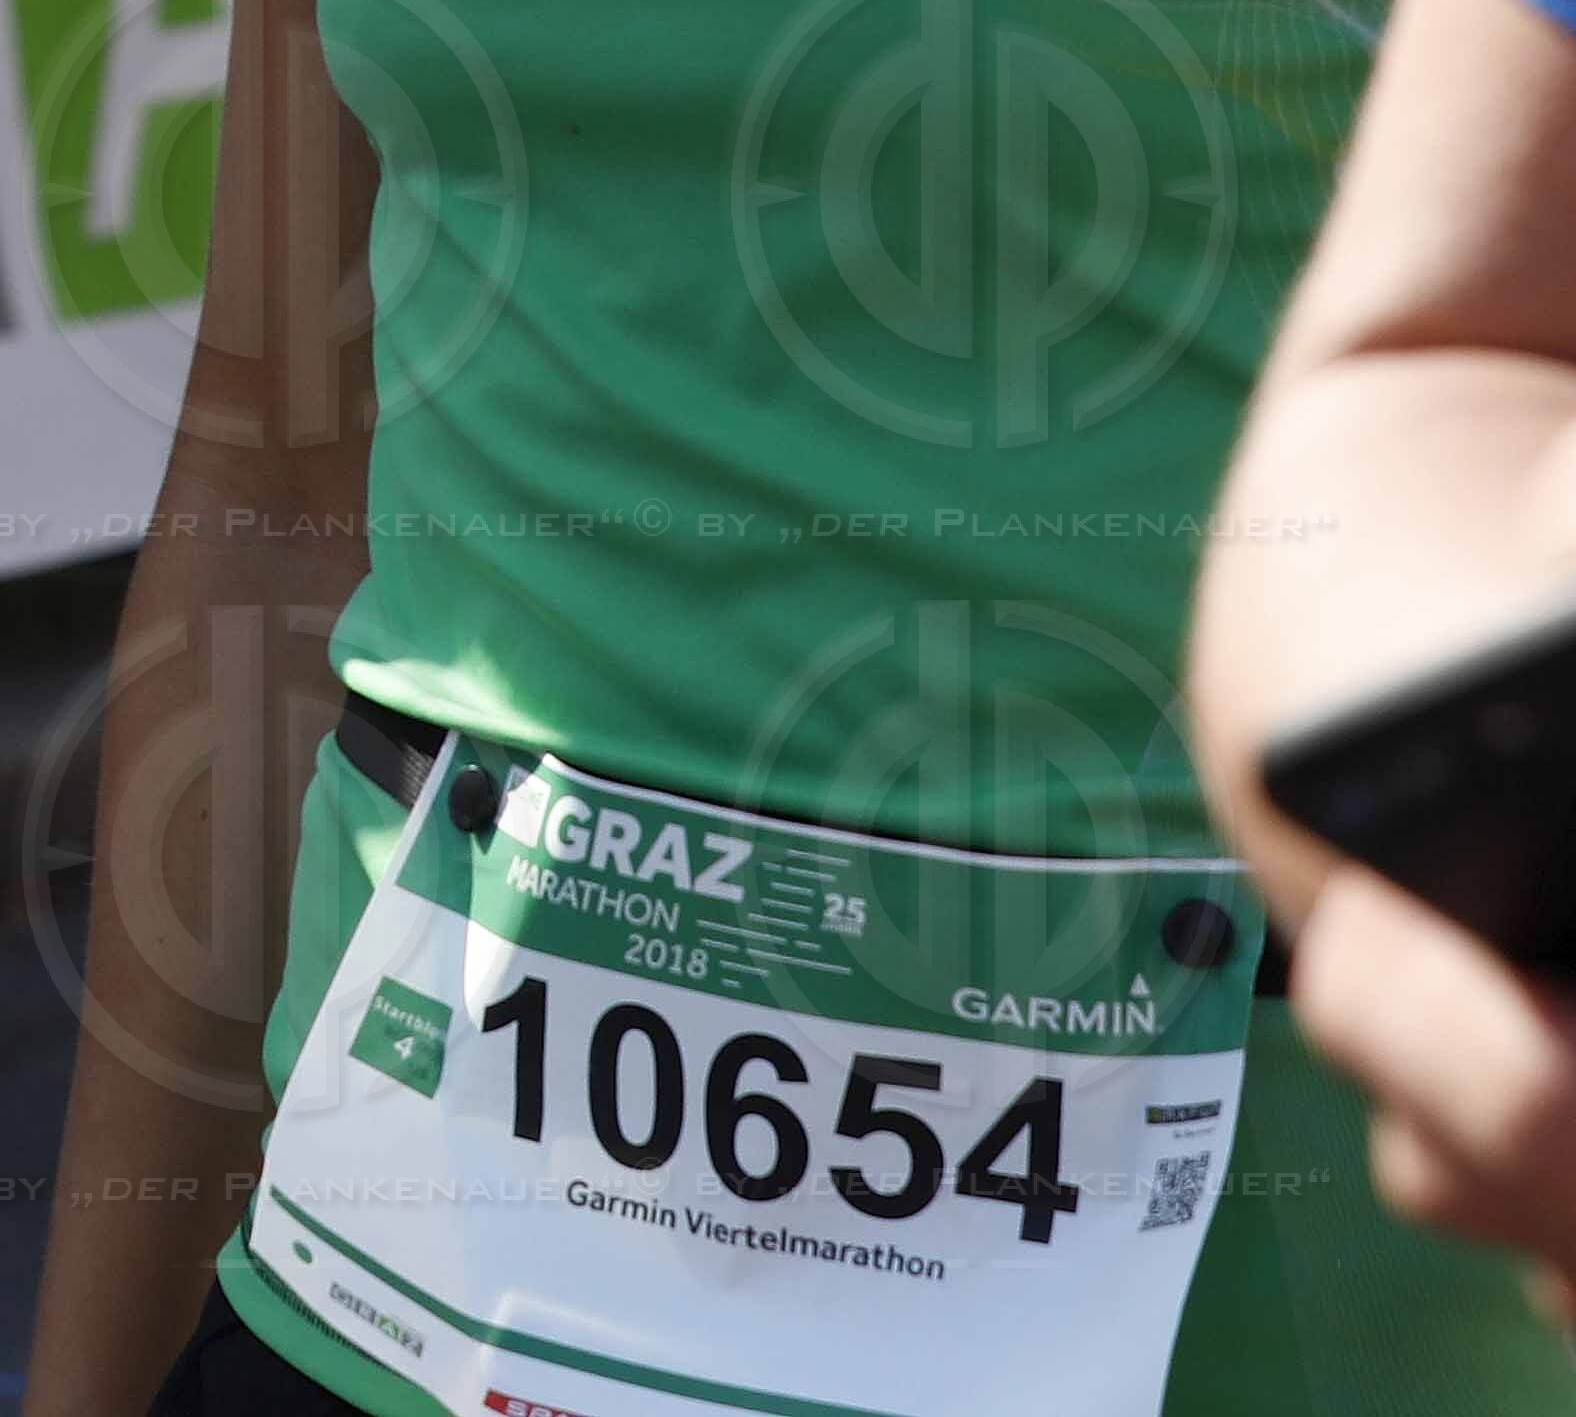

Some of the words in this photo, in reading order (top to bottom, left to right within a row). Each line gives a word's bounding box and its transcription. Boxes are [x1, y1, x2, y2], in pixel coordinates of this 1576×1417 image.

[544, 792, 755, 905] GRAZ
[505, 854, 682, 935] MARATHON
[822, 892, 867, 926] 25
[622, 932, 709, 981] 2018
[951, 986, 1158, 1037] GARMIN
[393, 1035, 416, 1061] 4
[479, 973, 1080, 1246] 10654
[565, 1179, 678, 1231] Garmin
[684, 1207, 947, 1283] Viertelmarathon
